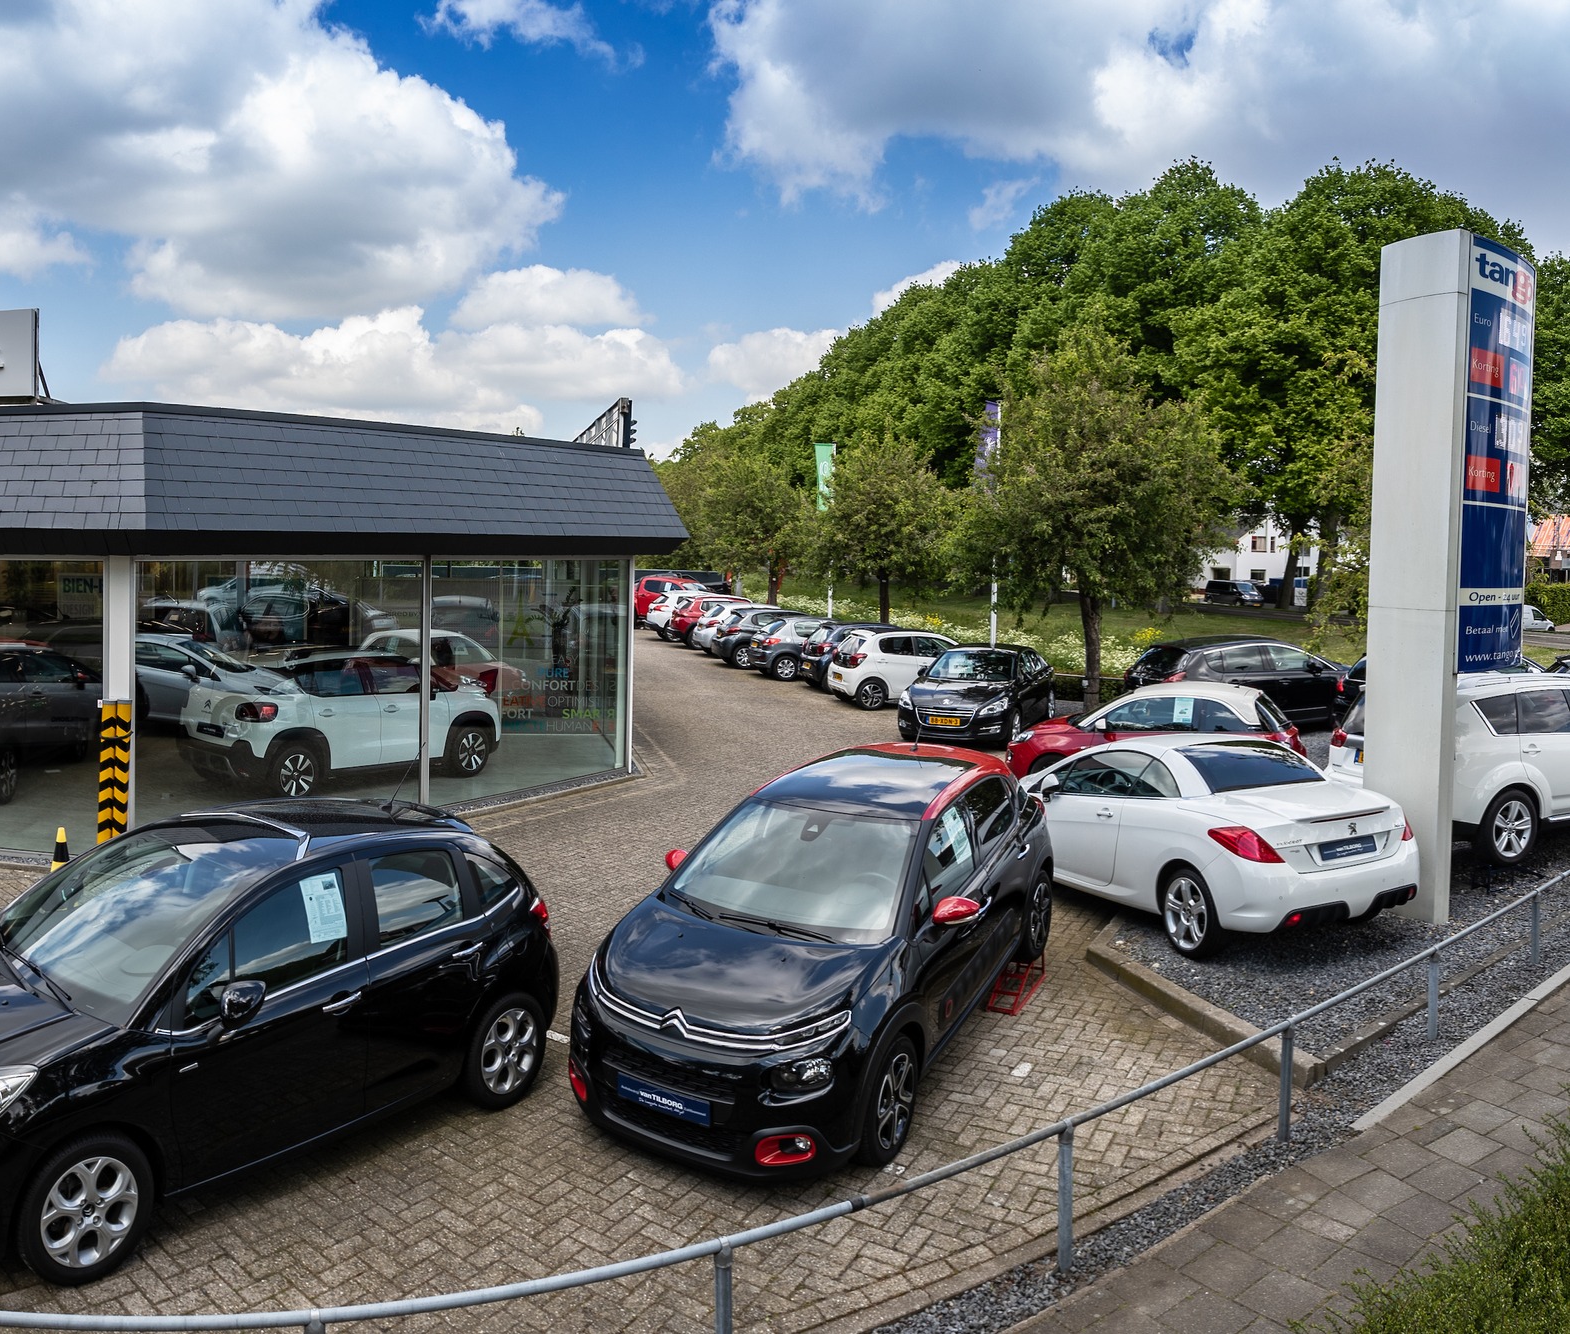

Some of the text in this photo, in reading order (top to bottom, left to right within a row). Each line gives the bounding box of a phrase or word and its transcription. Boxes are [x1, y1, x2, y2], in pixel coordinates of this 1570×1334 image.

[1475, 253, 1533, 305] tango
[1474, 313, 1492, 327] Euro
[1472, 358, 1499, 379] Korting
[1470, 420, 1491, 434] Diesel
[1468, 465, 1495, 482] Korting
[1469, 591, 1496, 604] Open
[1465, 625, 1494, 635] Betaal
[551, 654, 578, 665] EASY
[537, 667, 569, 678] PURE
